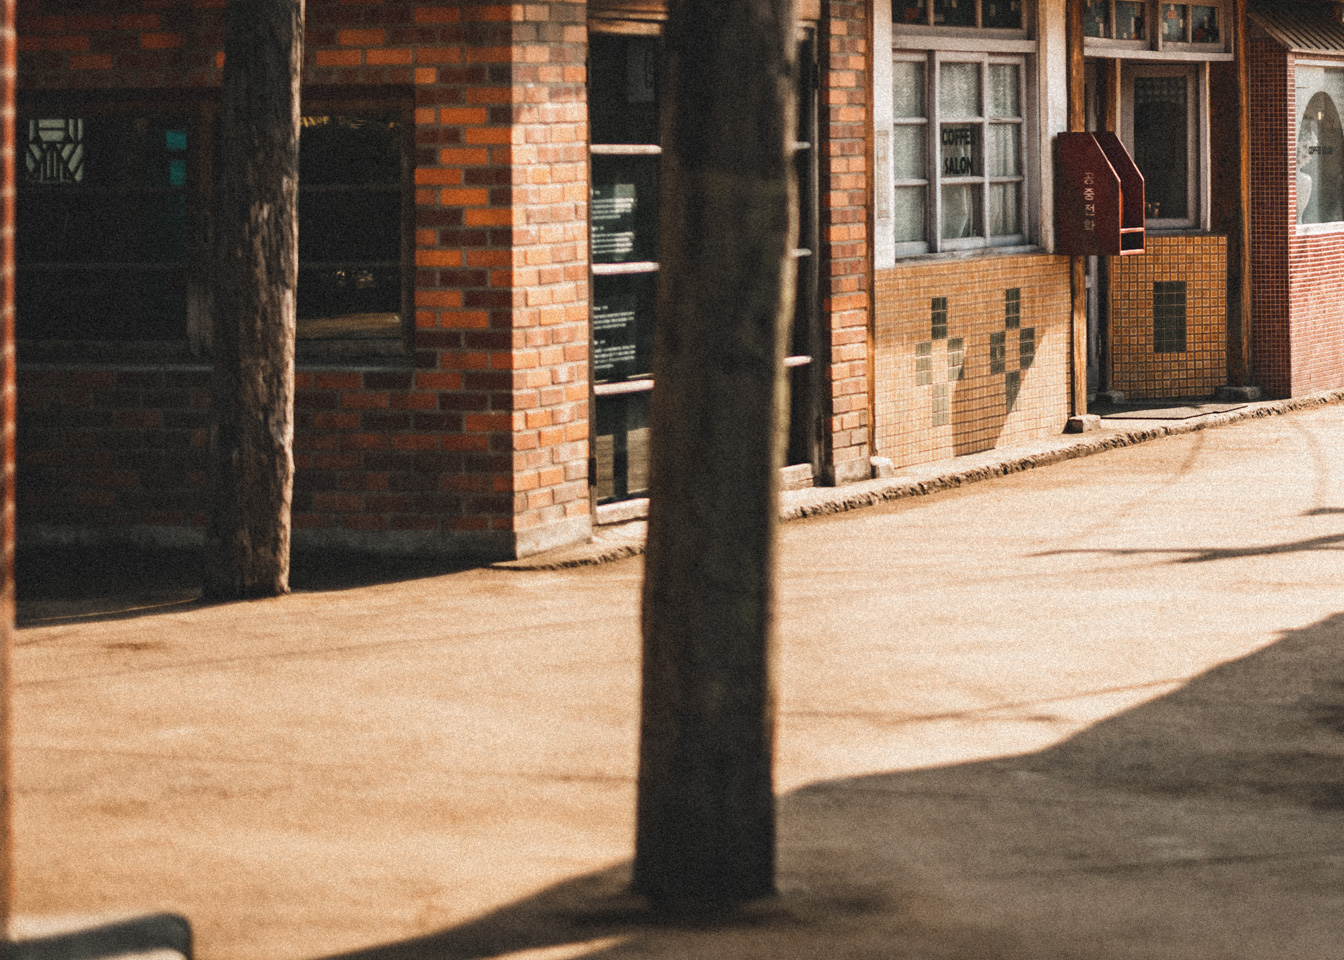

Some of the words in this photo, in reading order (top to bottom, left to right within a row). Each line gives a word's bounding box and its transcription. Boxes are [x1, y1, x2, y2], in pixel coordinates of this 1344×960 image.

[941, 128, 976, 146] COFFEE
[944, 156, 974, 175] SALON
[1083, 171, 1096, 231] 공중전화
